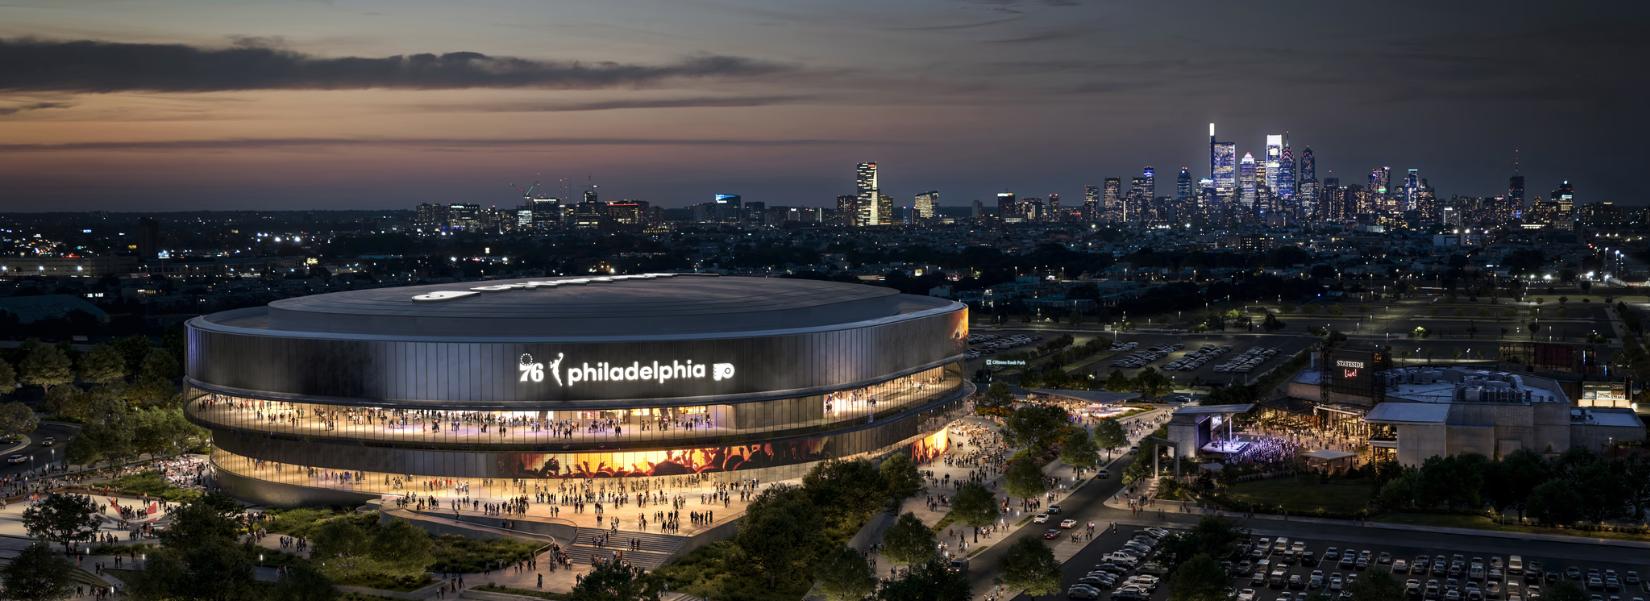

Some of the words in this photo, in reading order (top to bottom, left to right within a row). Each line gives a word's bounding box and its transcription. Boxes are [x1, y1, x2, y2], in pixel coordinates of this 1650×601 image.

[519, 362, 544, 382] 76
[568, 360, 706, 386] philadelphia
[1336, 360, 1364, 369] STATESIDE
